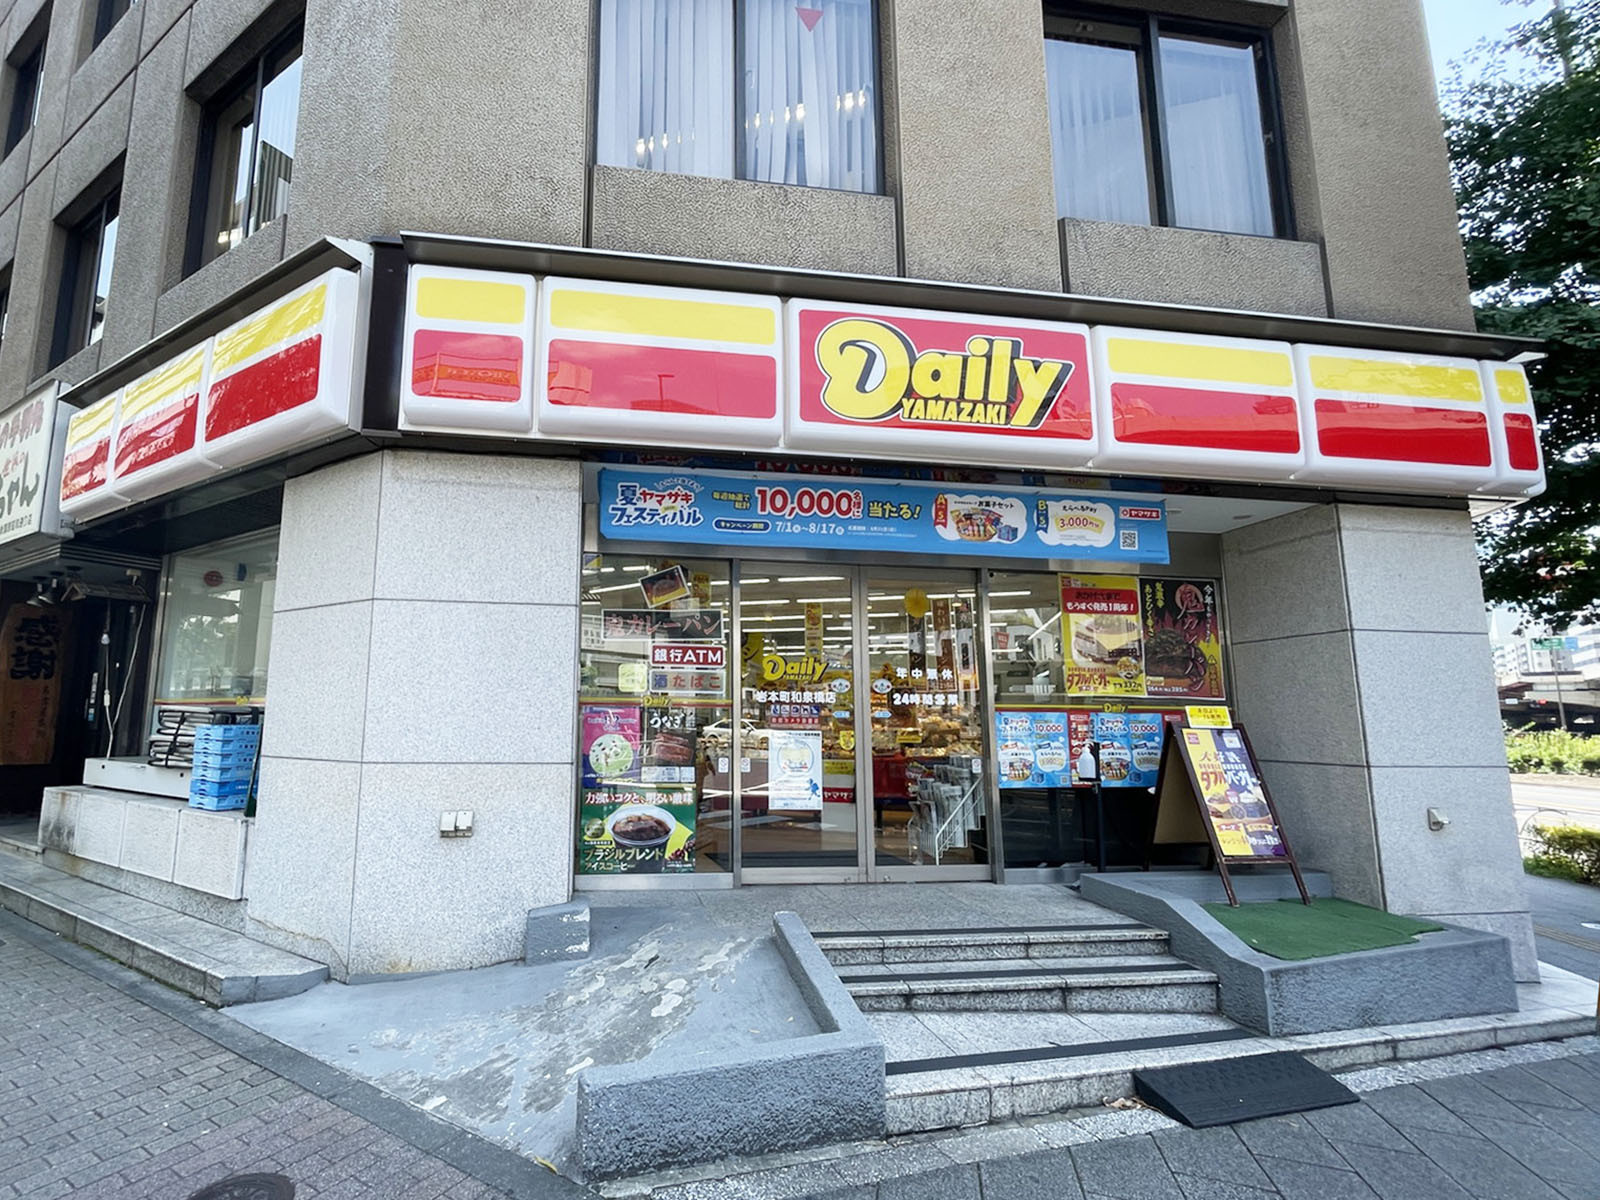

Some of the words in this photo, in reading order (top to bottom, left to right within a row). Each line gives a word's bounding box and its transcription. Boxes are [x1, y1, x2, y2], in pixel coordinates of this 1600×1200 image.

[816, 318, 1074, 428] Daily
[901, 398, 1009, 425] YAMAZAKI
[755, 487, 853, 519] 10,000
[937, 493, 945, 504] A
[1037, 500, 1046, 510] B
[609, 505, 703, 527] フェスティバル
[654, 648, 722, 664] 銀行ATM
[762, 655, 830, 682] Daily
[650, 712, 686, 729] うなぎ
[585, 847, 664, 861] ブラジルブレンド
